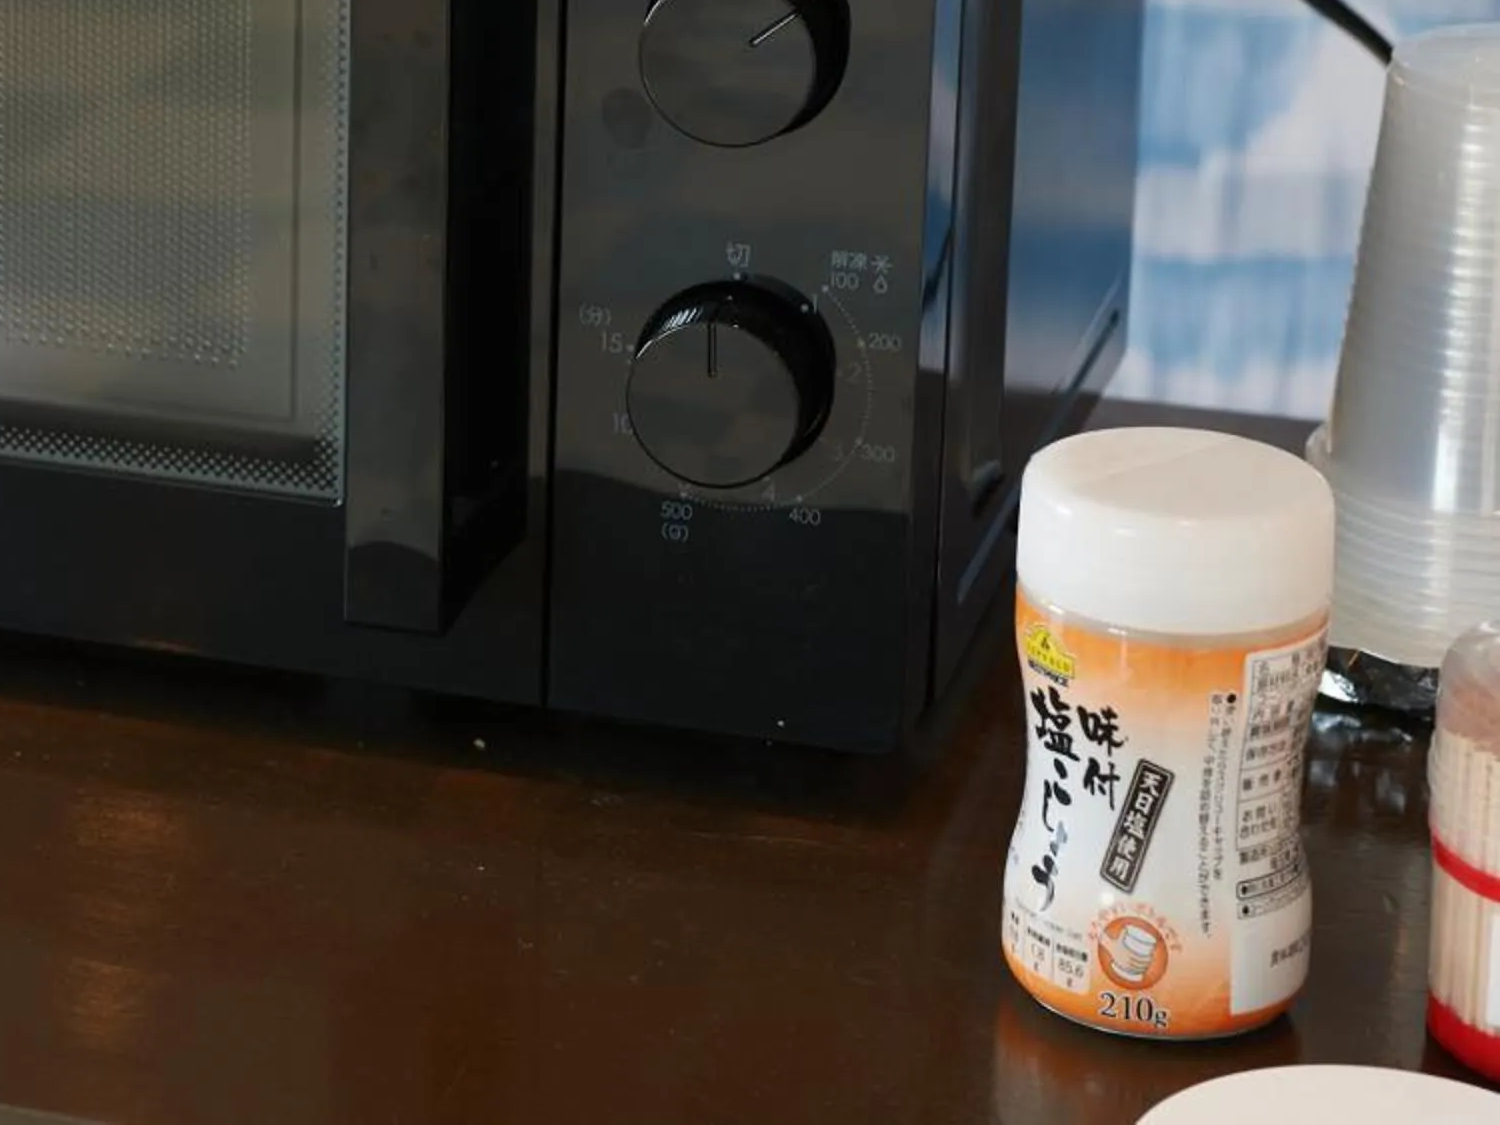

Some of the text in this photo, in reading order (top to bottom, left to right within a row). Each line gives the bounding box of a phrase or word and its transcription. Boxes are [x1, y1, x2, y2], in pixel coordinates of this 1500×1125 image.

[726, 242, 751, 268] 切
[830, 271, 860, 291] 100
[601, 330, 623, 353] 15
[868, 332, 901, 353] 200
[861, 443, 896, 463] 300
[660, 501, 693, 521] 500
[788, 508, 821, 527] 400
[1077, 704, 1127, 811] 味付
[1099, 992, 1167, 1029] 210g
